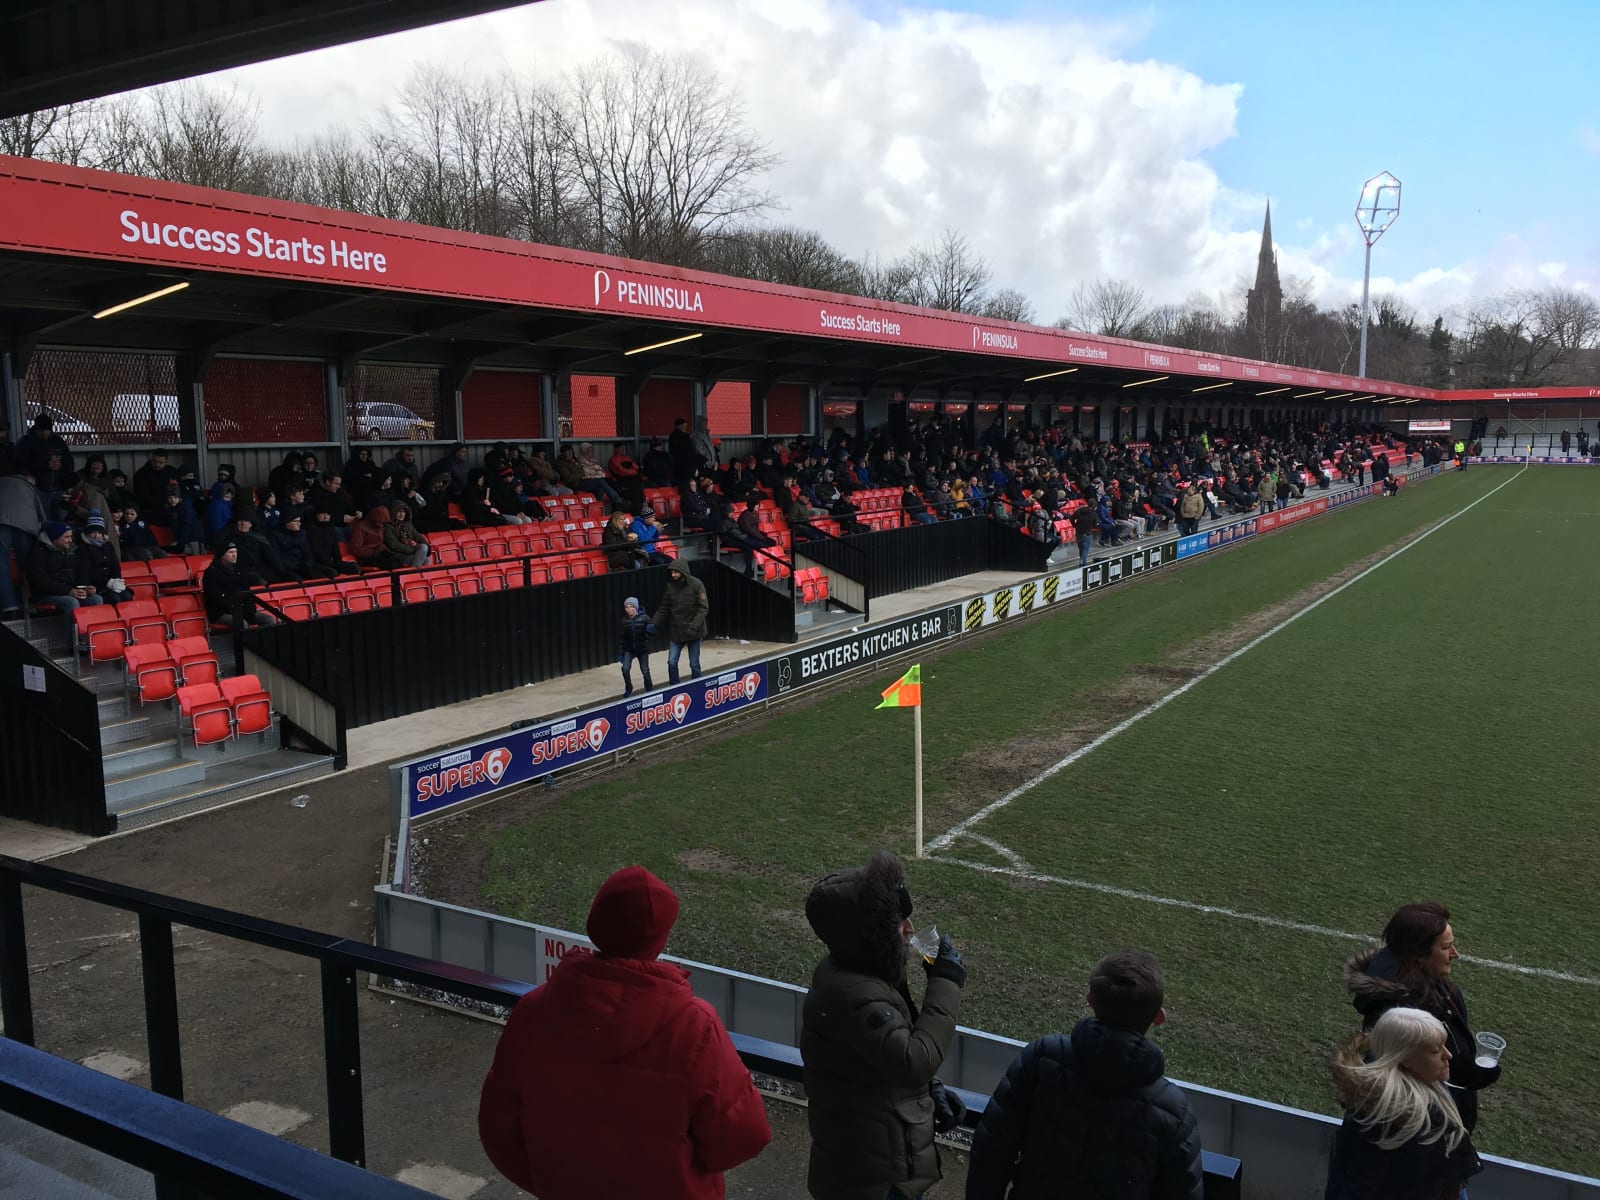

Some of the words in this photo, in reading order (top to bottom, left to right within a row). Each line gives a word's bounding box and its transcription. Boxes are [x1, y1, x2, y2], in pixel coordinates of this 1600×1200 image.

[120, 210, 241, 255] Success
[246, 227, 325, 265] Starts
[330, 239, 387, 273] Here
[618, 280, 704, 312] PENINSULA
[820, 310, 855, 330] Success
[856, 315, 881, 333] Starts
[882, 318, 901, 335] Here
[982, 332, 1018, 350] PENINSULA
[1068, 344, 1087, 356] Success
[1086, 346, 1099, 358] Starts
[801, 641, 860, 678] BEXTERS
[862, 625, 909, 658] KITCHEN
[911, 623, 919, 641] &
[921, 617, 941, 638] BAR
[626, 702, 642, 711] soccer
[532, 728, 551, 739] soccer
[552, 720, 576, 735] saturday
[417, 761, 440, 773] soccer
[441, 751, 471, 767] saturday
[544, 938, 566, 960] NO
